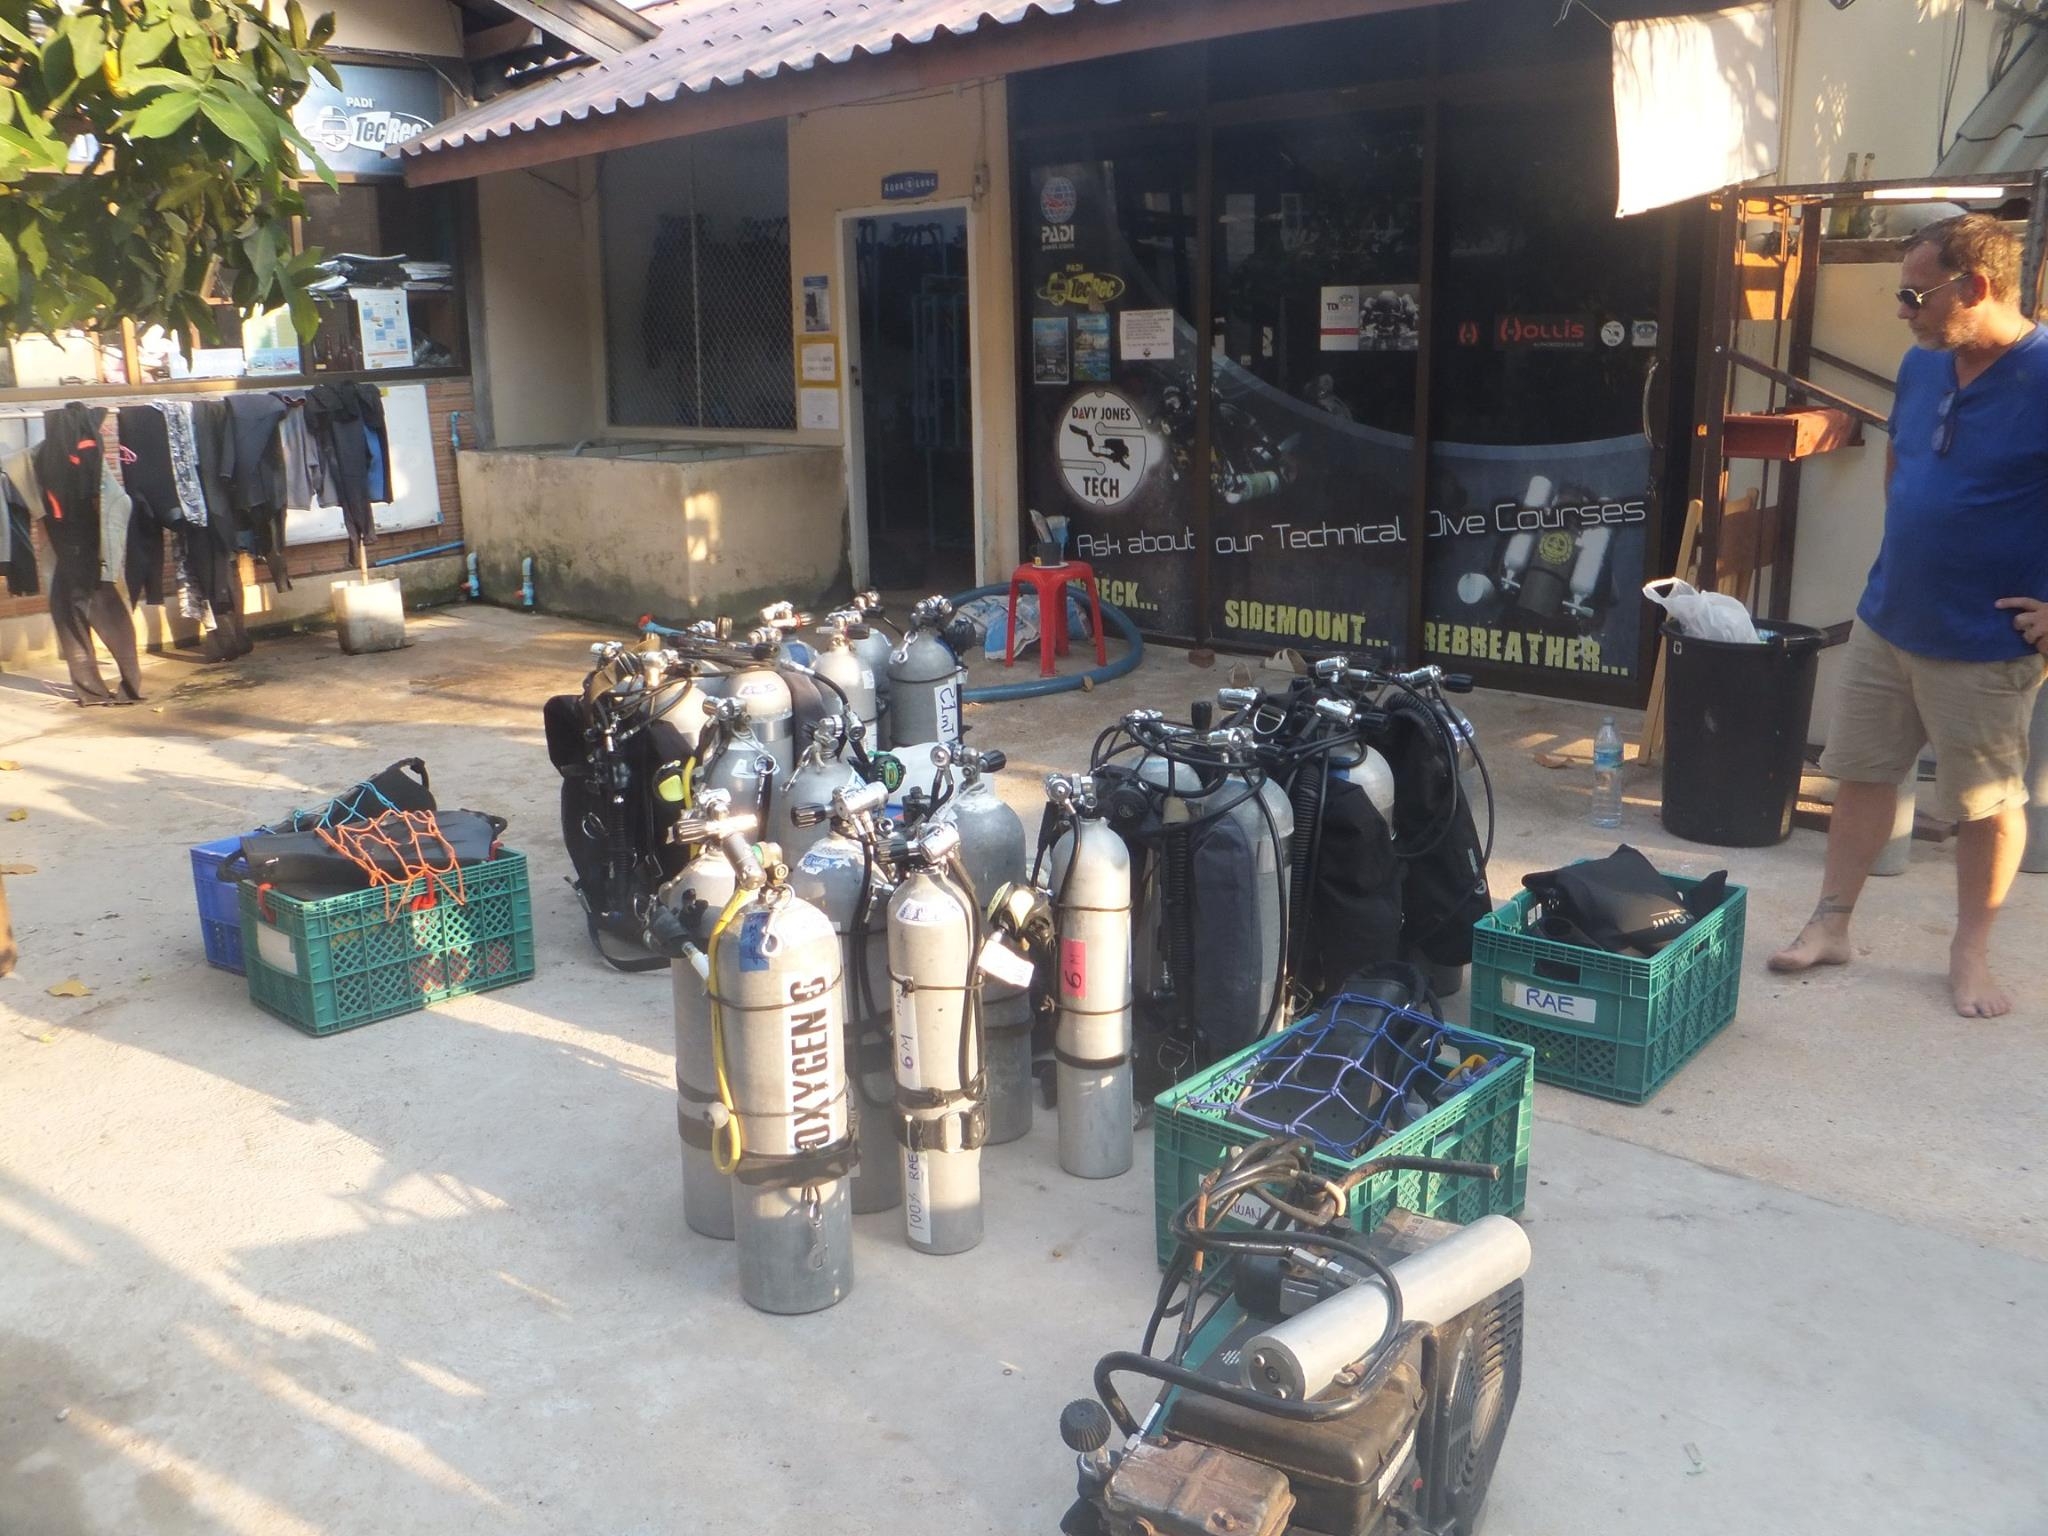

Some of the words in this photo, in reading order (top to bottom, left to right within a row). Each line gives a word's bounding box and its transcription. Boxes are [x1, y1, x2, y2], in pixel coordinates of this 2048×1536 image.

[347, 97, 373, 108] PADI
[1041, 224, 1074, 243] PADI
[1072, 407, 1097, 419] DAVY
[1101, 407, 1131, 421] JONES
[1083, 476, 1119, 498] TECH
[1077, 533, 1121, 557] Ask
[1128, 526, 1196, 554] about
[1216, 534, 1264, 554] our
[1271, 515, 1407, 550] Technical
[1495, 501, 1646, 532] Courses
[1225, 599, 1389, 647] SIDEMOUNT...
[1424, 621, 1629, 676] REBREATHER...
[1526, 986, 1575, 1016] RAE
[791, 1008, 831, 1150] OXYGEN
[907, 1153, 920, 1181] RAE
